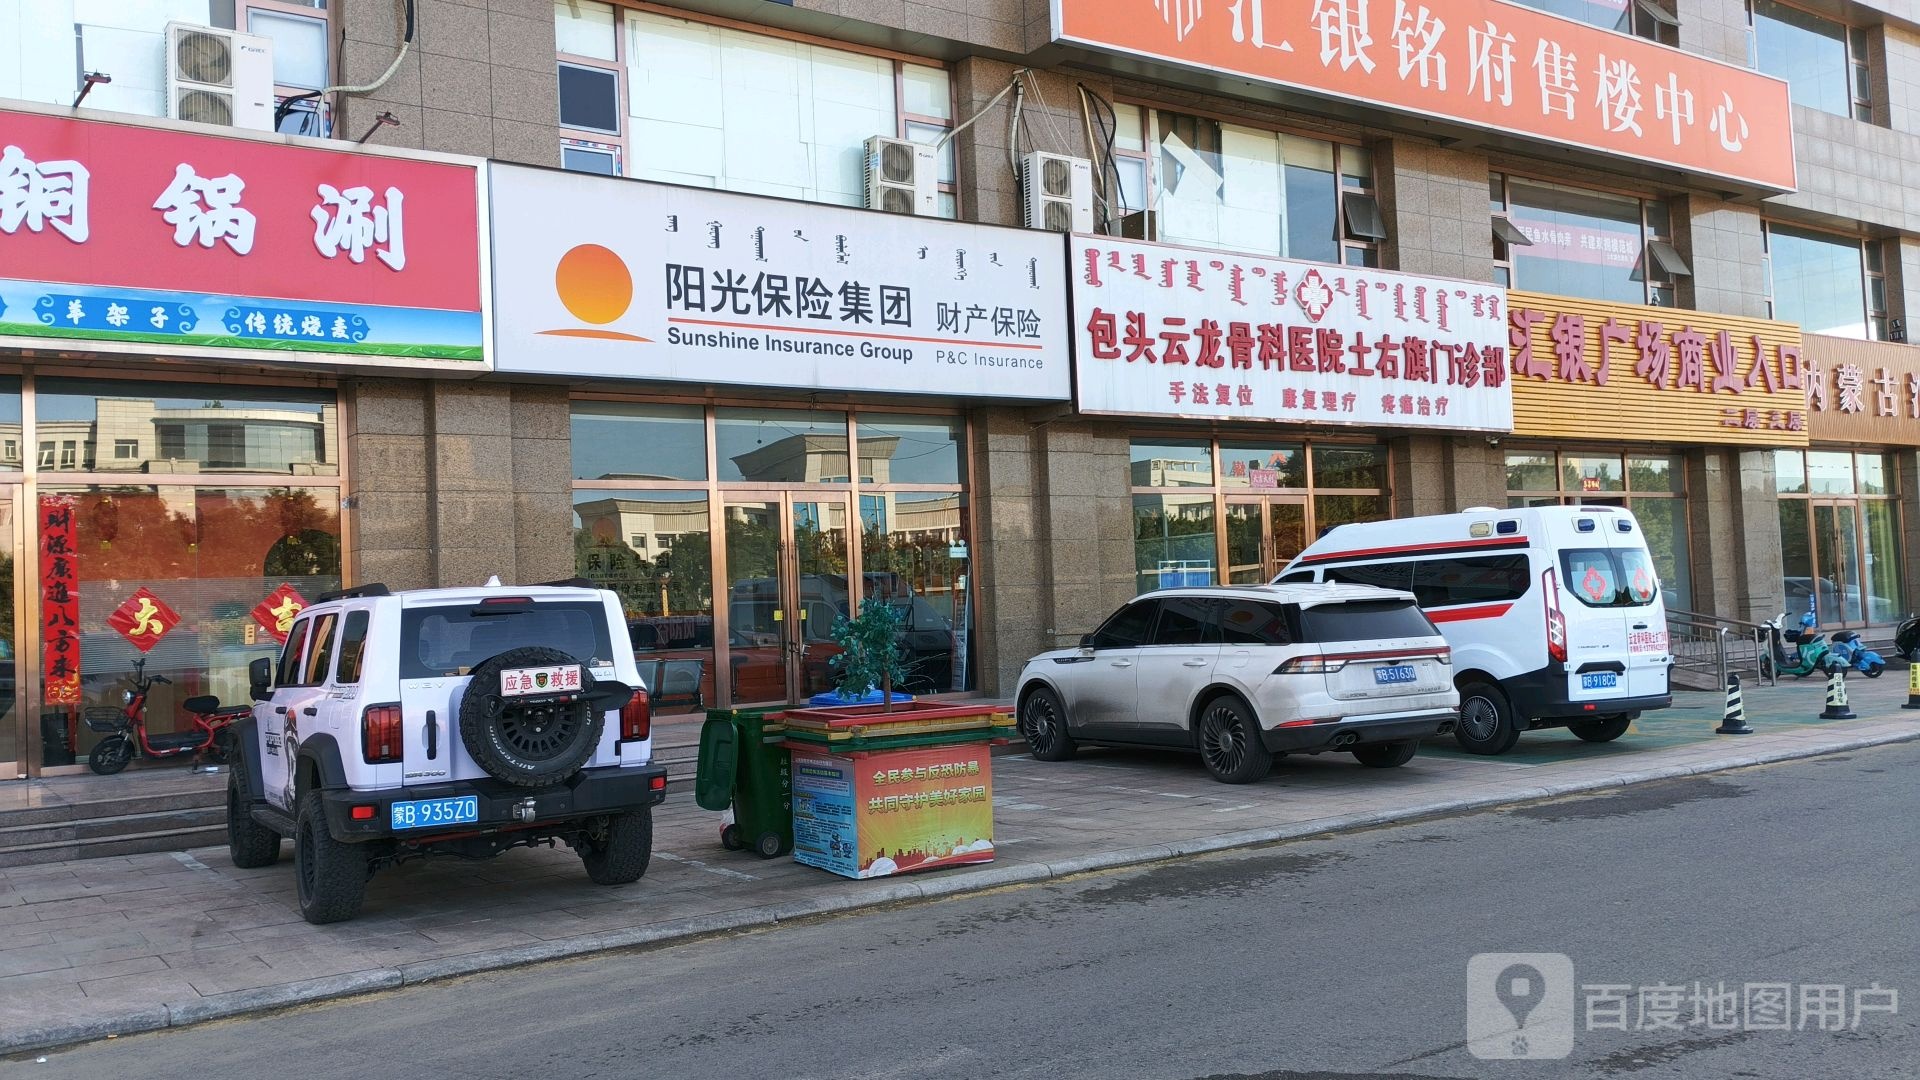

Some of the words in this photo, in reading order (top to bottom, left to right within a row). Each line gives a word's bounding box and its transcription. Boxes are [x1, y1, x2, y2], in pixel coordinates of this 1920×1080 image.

[1228, 0, 1749, 152] 汇银铭府售楼中心
[0, 145, 406, 272] 铜锅涮
[66, 299, 169, 329] 羊架子
[666, 262, 911, 328] 阳光保险集团
[245, 311, 350, 341] 传统烧麦
[937, 301, 1041, 340] 财产保险
[667, 326, 759, 352] Sunshine
[765, 332, 855, 358] Insurance
[860, 339, 913, 365] Group
[936, 349, 968, 366] P&C
[974, 352, 1043, 370] Insurance
[1087, 306, 1506, 388] 包头云龙骨科医院土右旗门诊部
[1510, 308, 1802, 395] 汇银广场商业入口
[1168, 380, 1254, 407] 手法复位
[1281, 388, 1357, 413] 康复理疗
[1381, 394, 1449, 417] 疼痛治疗
[129, 597, 164, 636] 大
[270, 596, 302, 633] 吉
[505, 674, 533, 691] 应急
[550, 669, 578, 688] 救援
[872, 760, 980, 785] 全民参与反恐防暴
[868, 785, 987, 814] 共同守护美好家园
